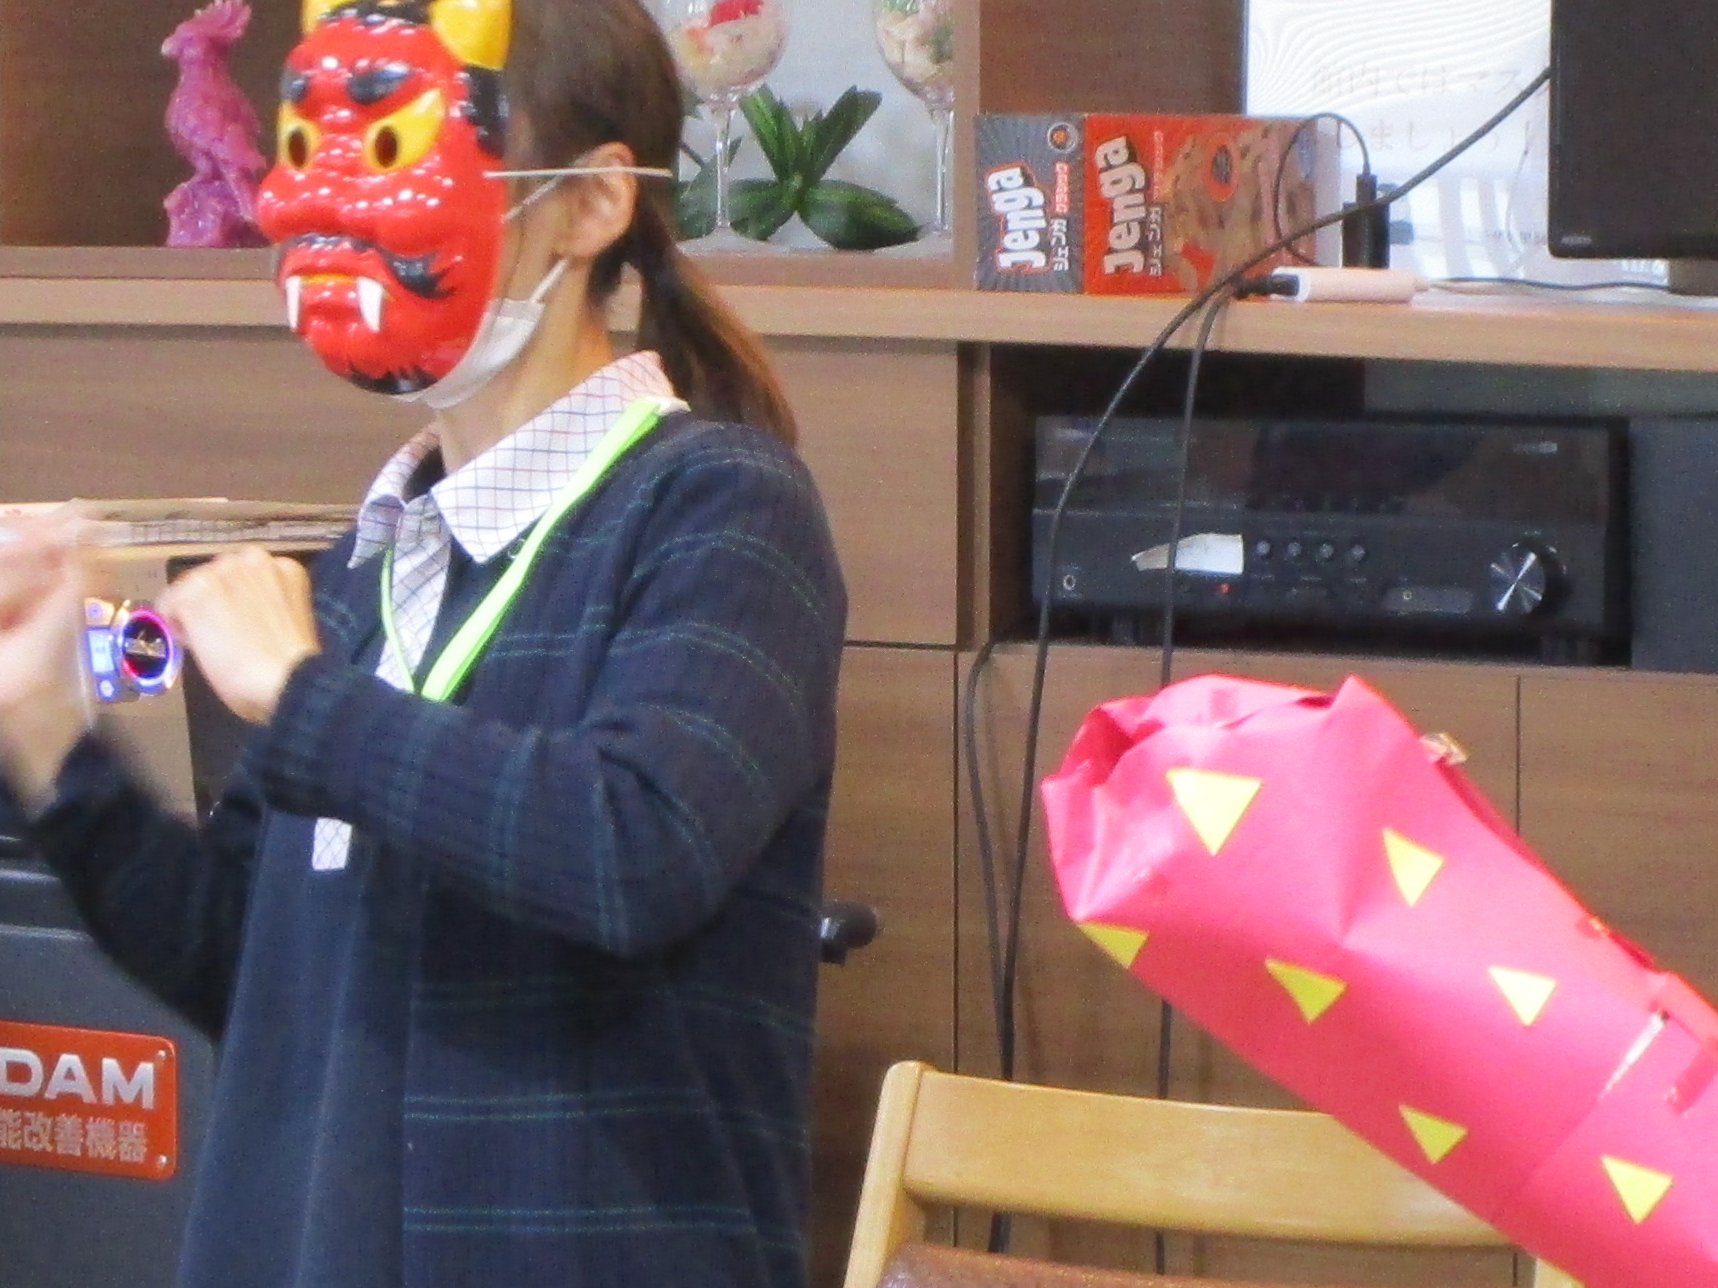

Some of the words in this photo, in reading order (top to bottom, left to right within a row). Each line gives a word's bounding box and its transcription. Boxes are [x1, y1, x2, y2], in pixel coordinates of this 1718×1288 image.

[987, 165, 1048, 270] Jenga
[1050, 218, 1070, 271] ジェンガ
[1094, 135, 1147, 275] Jenga
